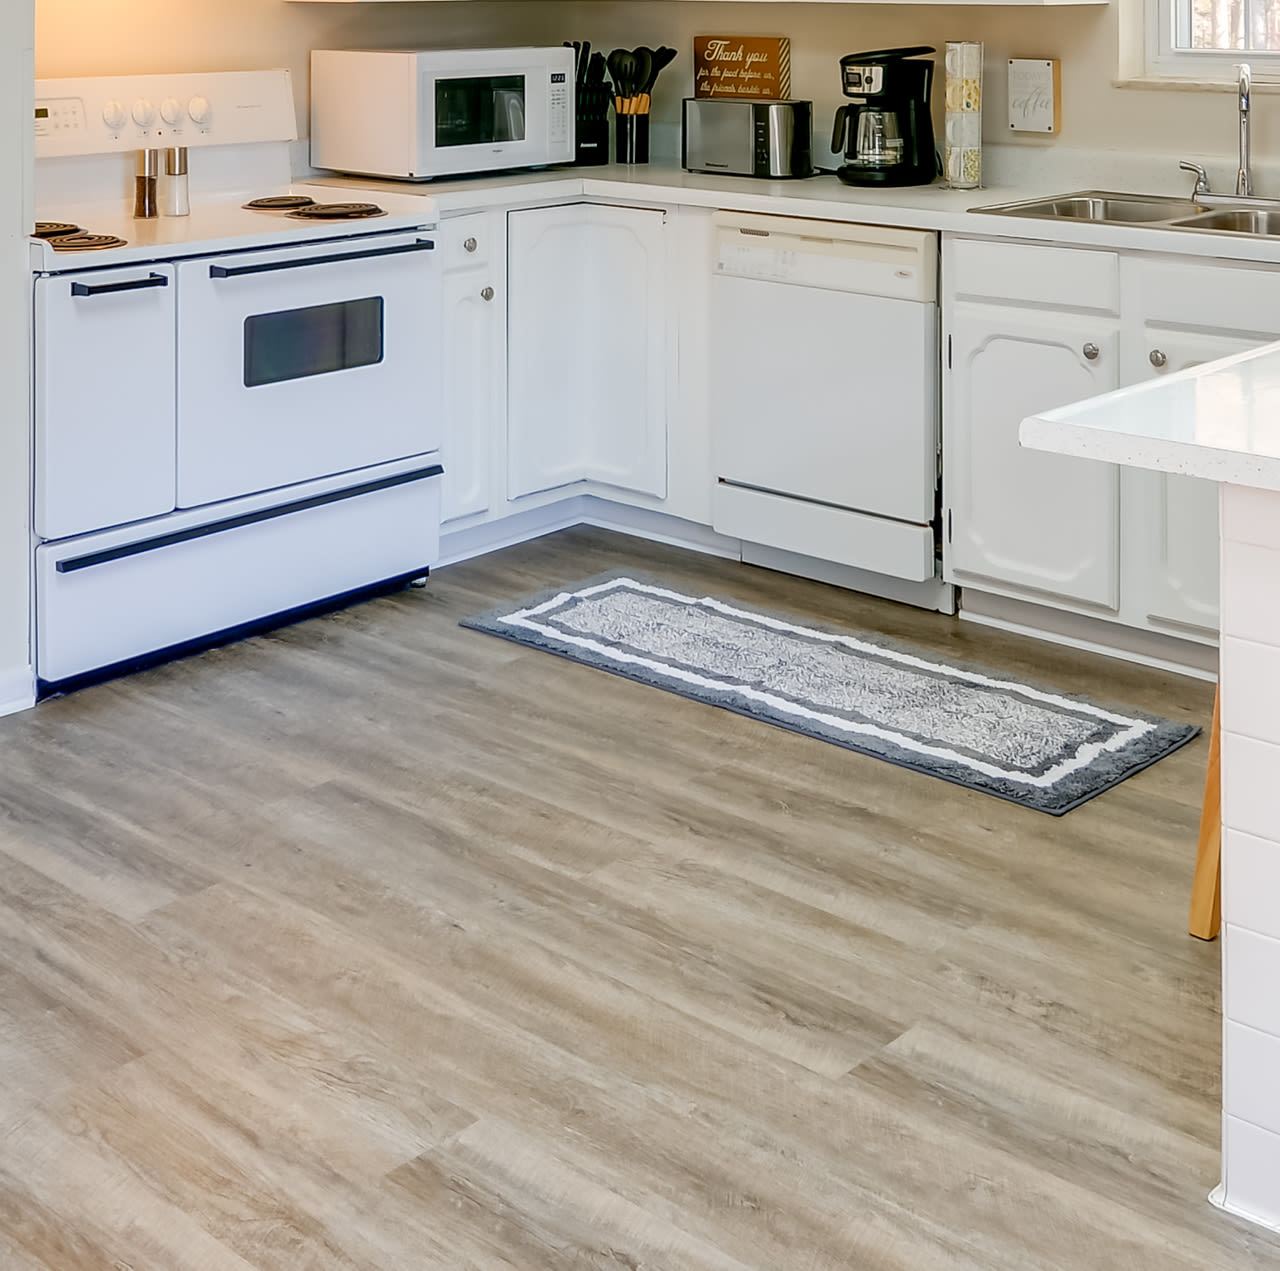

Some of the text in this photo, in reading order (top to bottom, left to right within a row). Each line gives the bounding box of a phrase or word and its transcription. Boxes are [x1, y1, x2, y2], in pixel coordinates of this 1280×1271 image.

[704, 40, 768, 69] Thank you
[696, 67, 709, 80] for
[710, 66, 721, 76] the
[721, 68, 739, 81] food
[700, 81, 711, 91] the
